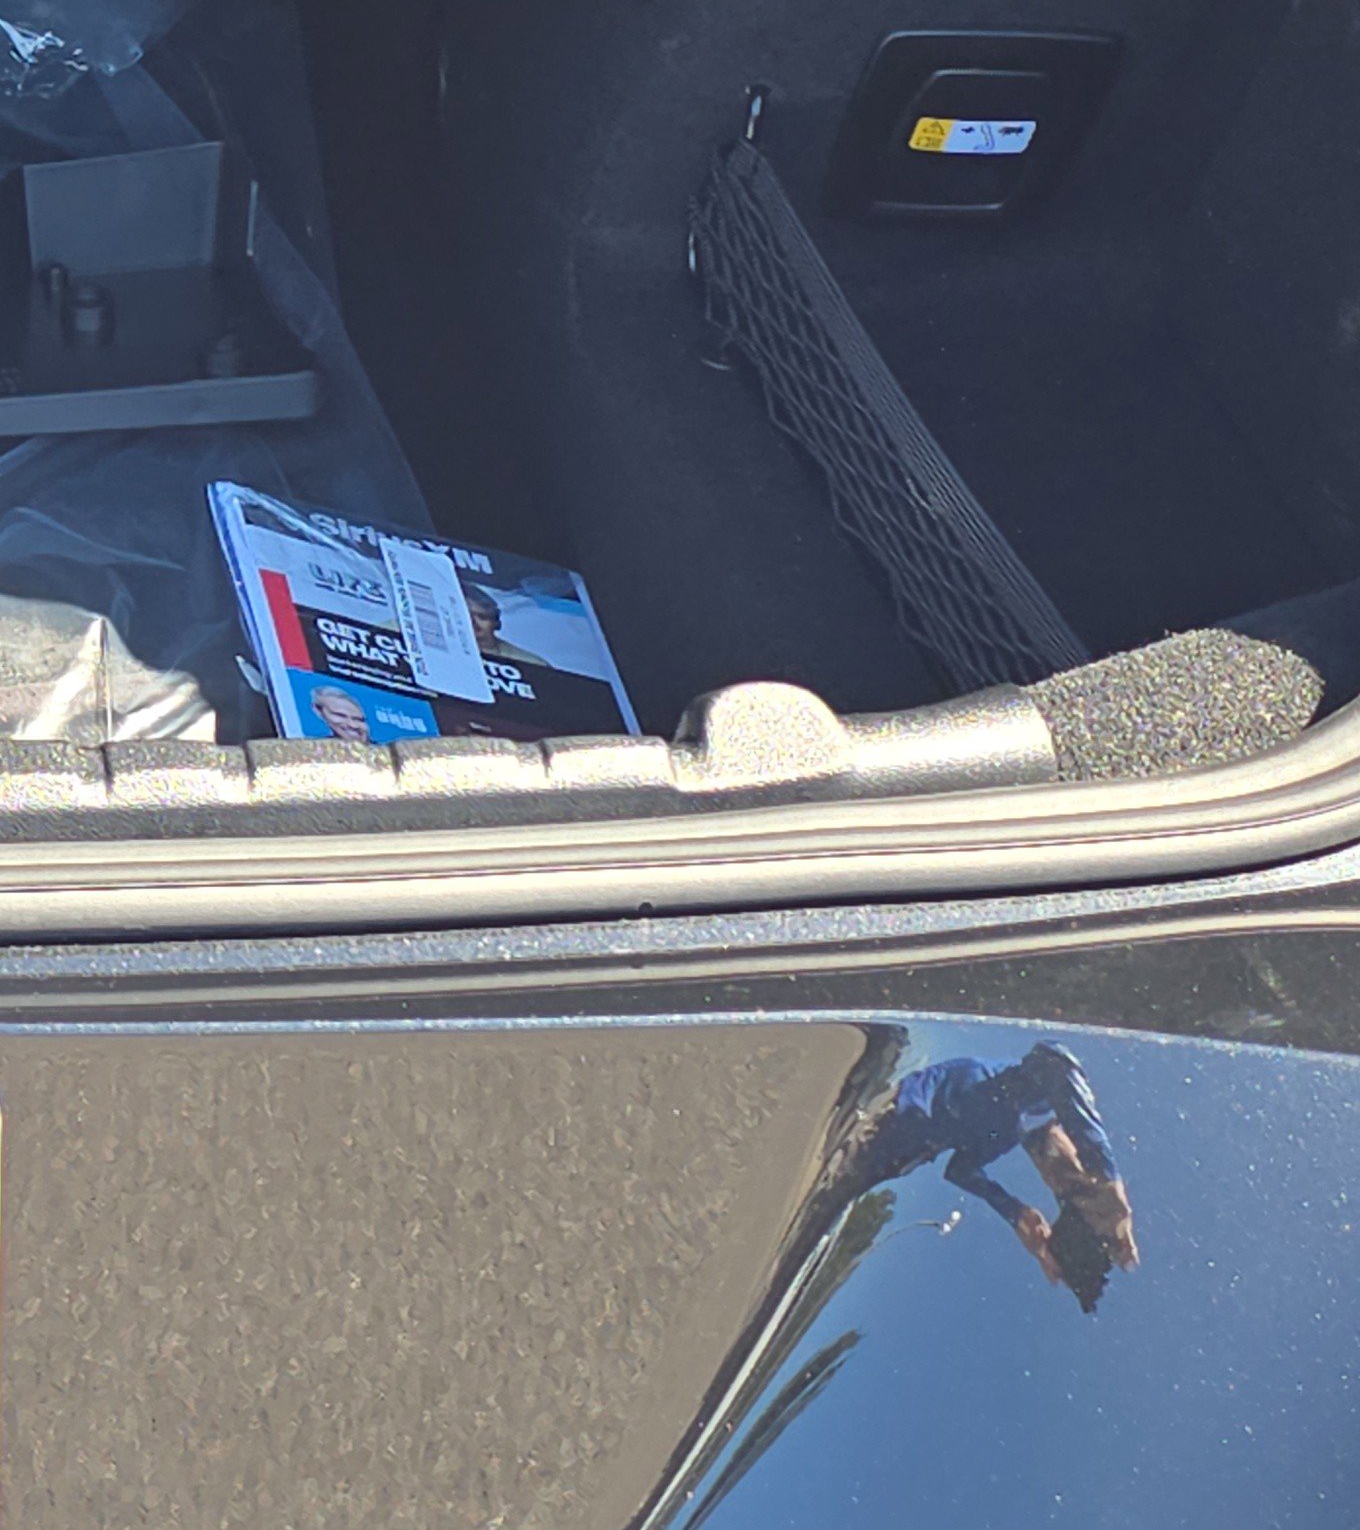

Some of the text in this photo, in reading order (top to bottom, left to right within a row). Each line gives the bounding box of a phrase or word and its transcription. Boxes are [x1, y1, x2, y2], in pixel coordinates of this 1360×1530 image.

[309, 513, 493, 574] SiriXM
[316, 618, 371, 643] GET
[319, 633, 399, 667] WHAT
[485, 676, 537, 700] OVE
